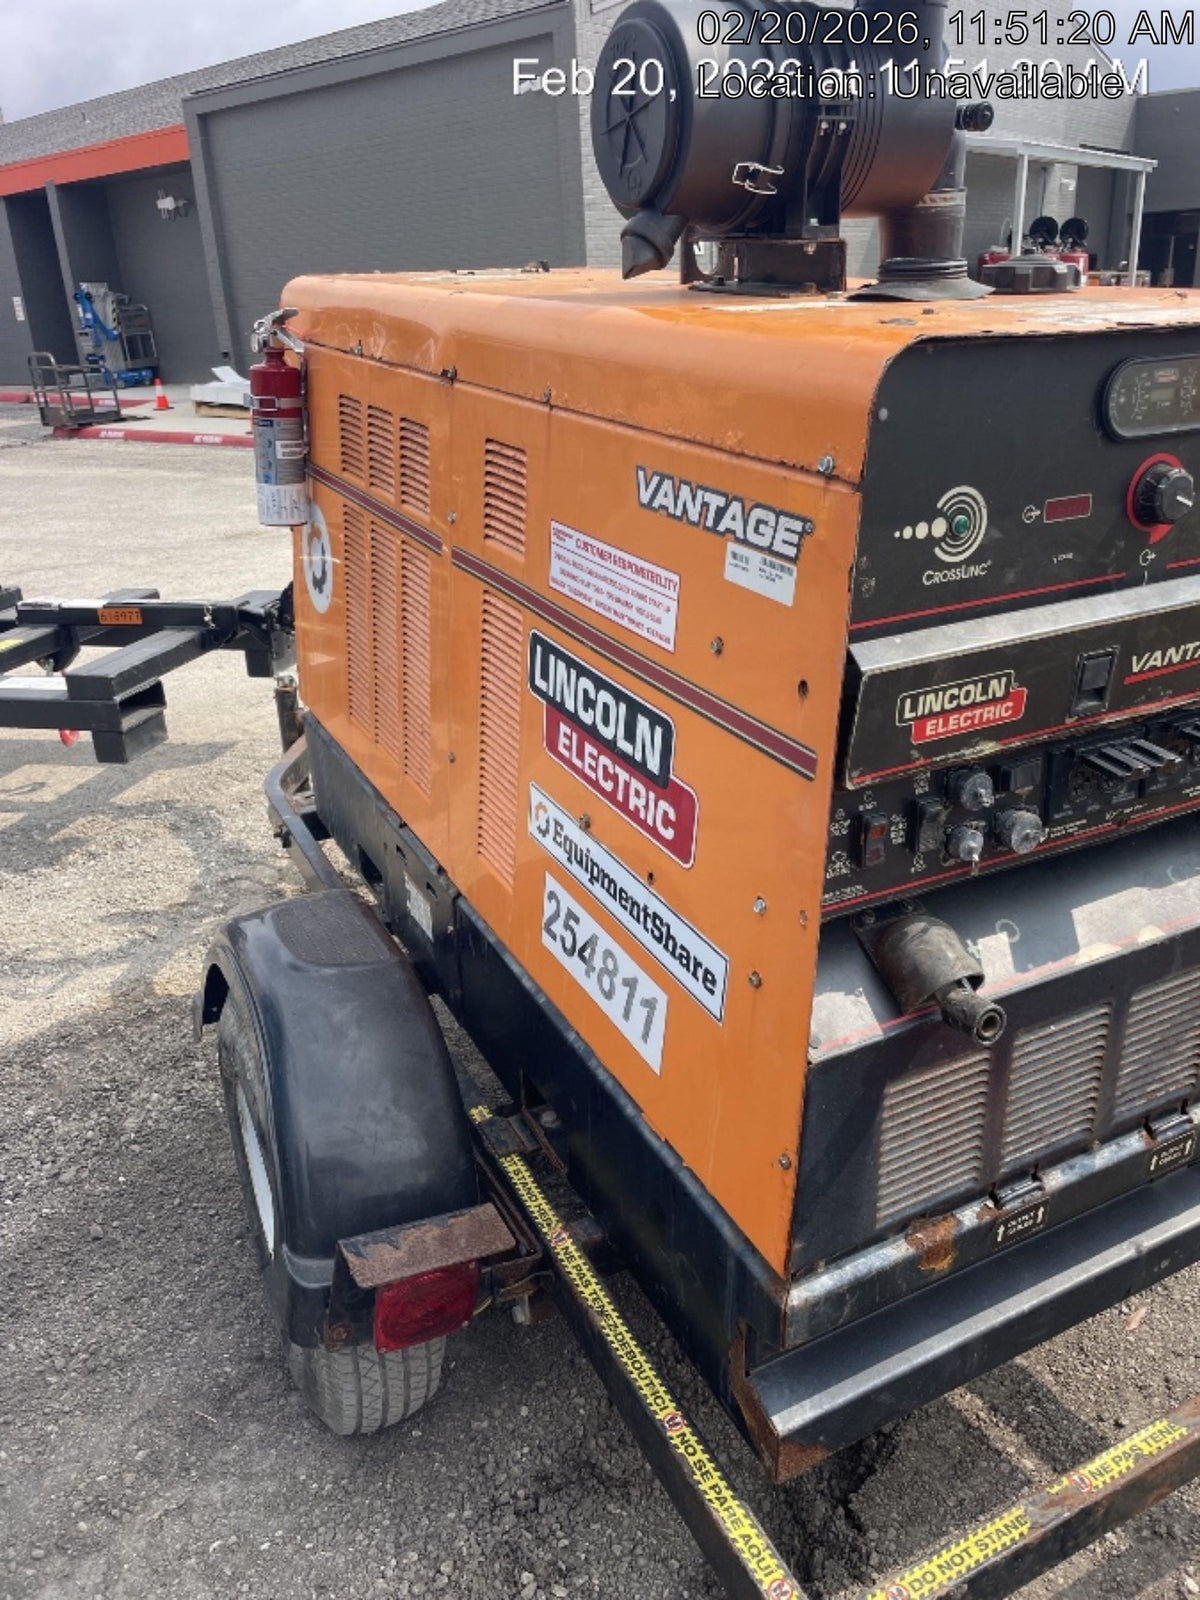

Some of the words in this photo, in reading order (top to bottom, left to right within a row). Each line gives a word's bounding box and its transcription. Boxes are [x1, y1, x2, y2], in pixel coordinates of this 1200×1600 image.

[636, 466, 804, 563] VANTAGE
[534, 644, 663, 776] LINCOLN
[903, 677, 1008, 719] LINCOLN
[925, 702, 1014, 737] ELECTRIC
[558, 721, 677, 841] ELECTRIC
[552, 817, 717, 997] EquipmentShare
[543, 889, 658, 1044] 254811
[562, 1246, 576, 1264] NE
[573, 1264, 592, 1288] PAS
[614, 1331, 658, 1389] DEBOUT
[677, 1432, 698, 1457] NO
[693, 1458, 713, 1483] SE
[709, 1482, 746, 1531] PARE
[1087, 1461, 1114, 1480] NE
[908, 1570, 937, 1593] DO
[937, 1546, 973, 1575] NOT
